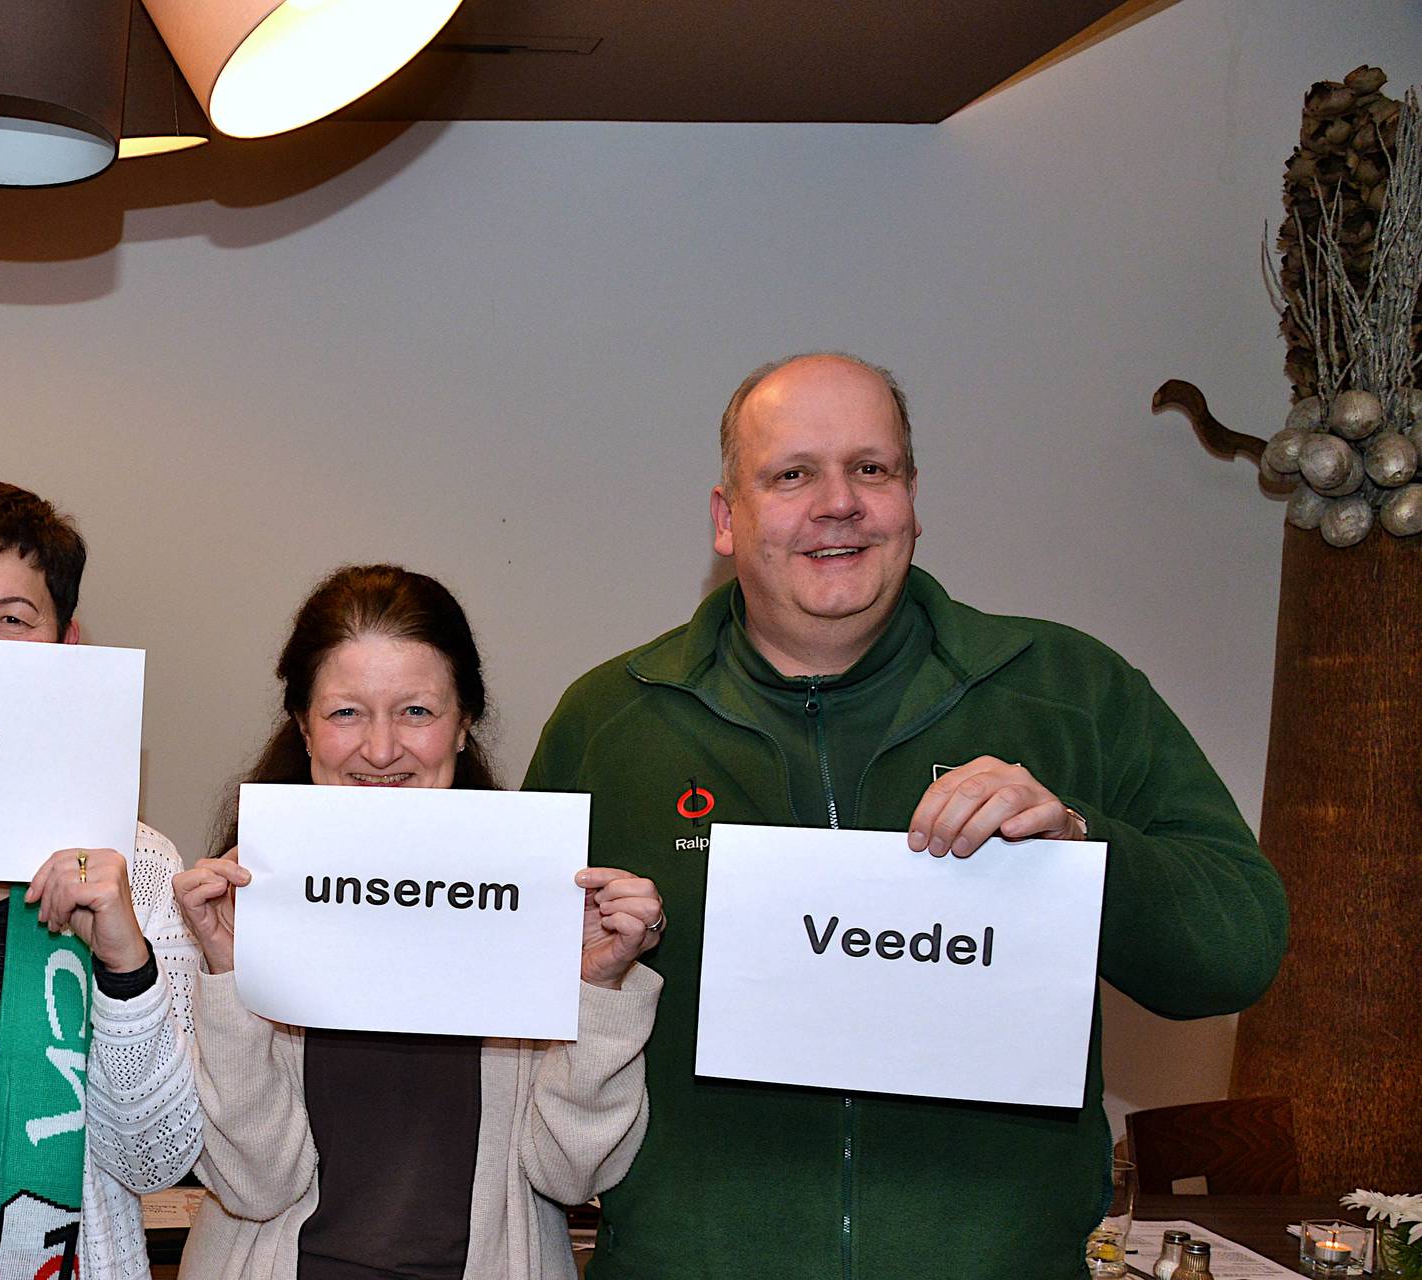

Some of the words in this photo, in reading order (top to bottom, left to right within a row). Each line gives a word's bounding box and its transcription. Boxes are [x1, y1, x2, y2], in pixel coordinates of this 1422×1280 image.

[675, 835, 710, 851] Ralp
[304, 875, 520, 912] unserem
[803, 914, 995, 967] Veedel
